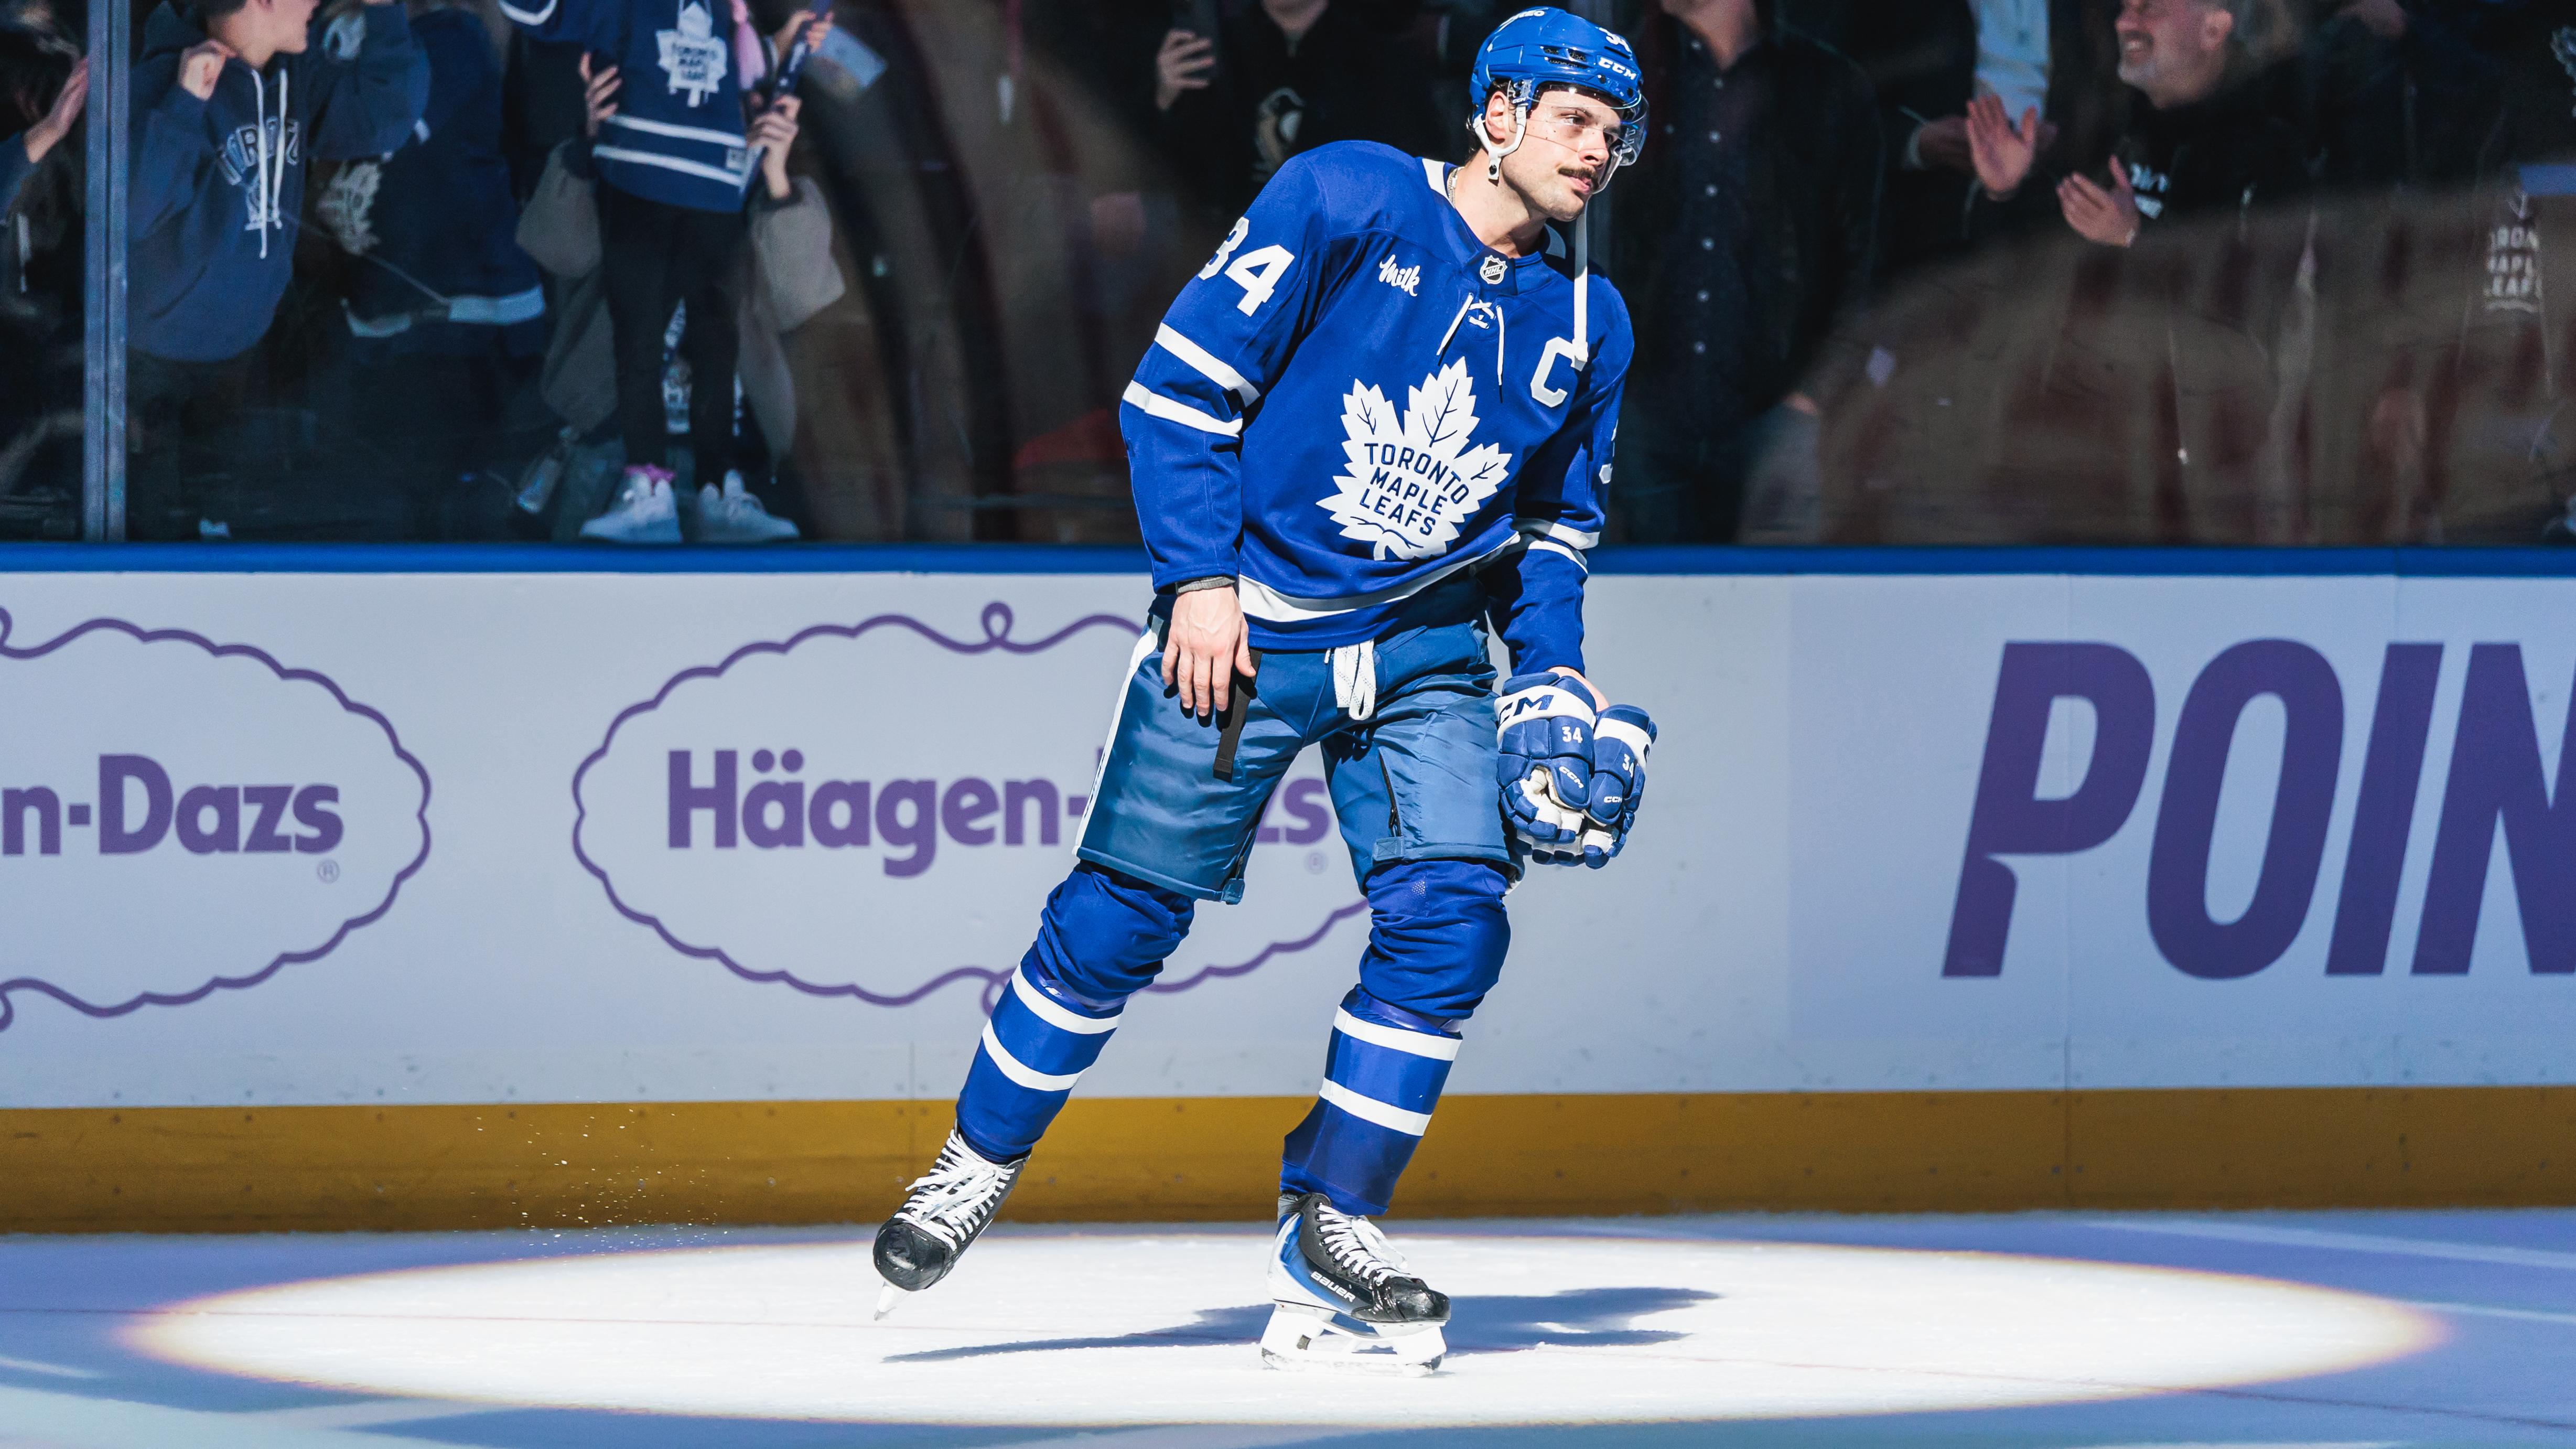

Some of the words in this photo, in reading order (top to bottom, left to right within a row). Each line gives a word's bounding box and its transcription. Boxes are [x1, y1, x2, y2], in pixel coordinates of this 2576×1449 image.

[1598, 57, 1636, 80] CCM
[1198, 217, 1295, 317] 34
[1379, 254, 1420, 297] Milk
[1484, 266, 1501, 276] NHL
[1530, 336, 1575, 408] C
[1364, 443, 1469, 505] TORONTO
[1370, 467, 1448, 515] MAPLE
[1359, 488, 1436, 535] LEAFS
[1561, 726, 1583, 743] 34
[1559, 766, 1584, 789] CCM
[1622, 753, 1635, 778] 34
[2, 753, 344, 855] n-Dazs
[668, 749, 1332, 878] Häagen-s
[1941, 638, 2576, 981] POIN
[1311, 1271, 1356, 1303] BAUER
